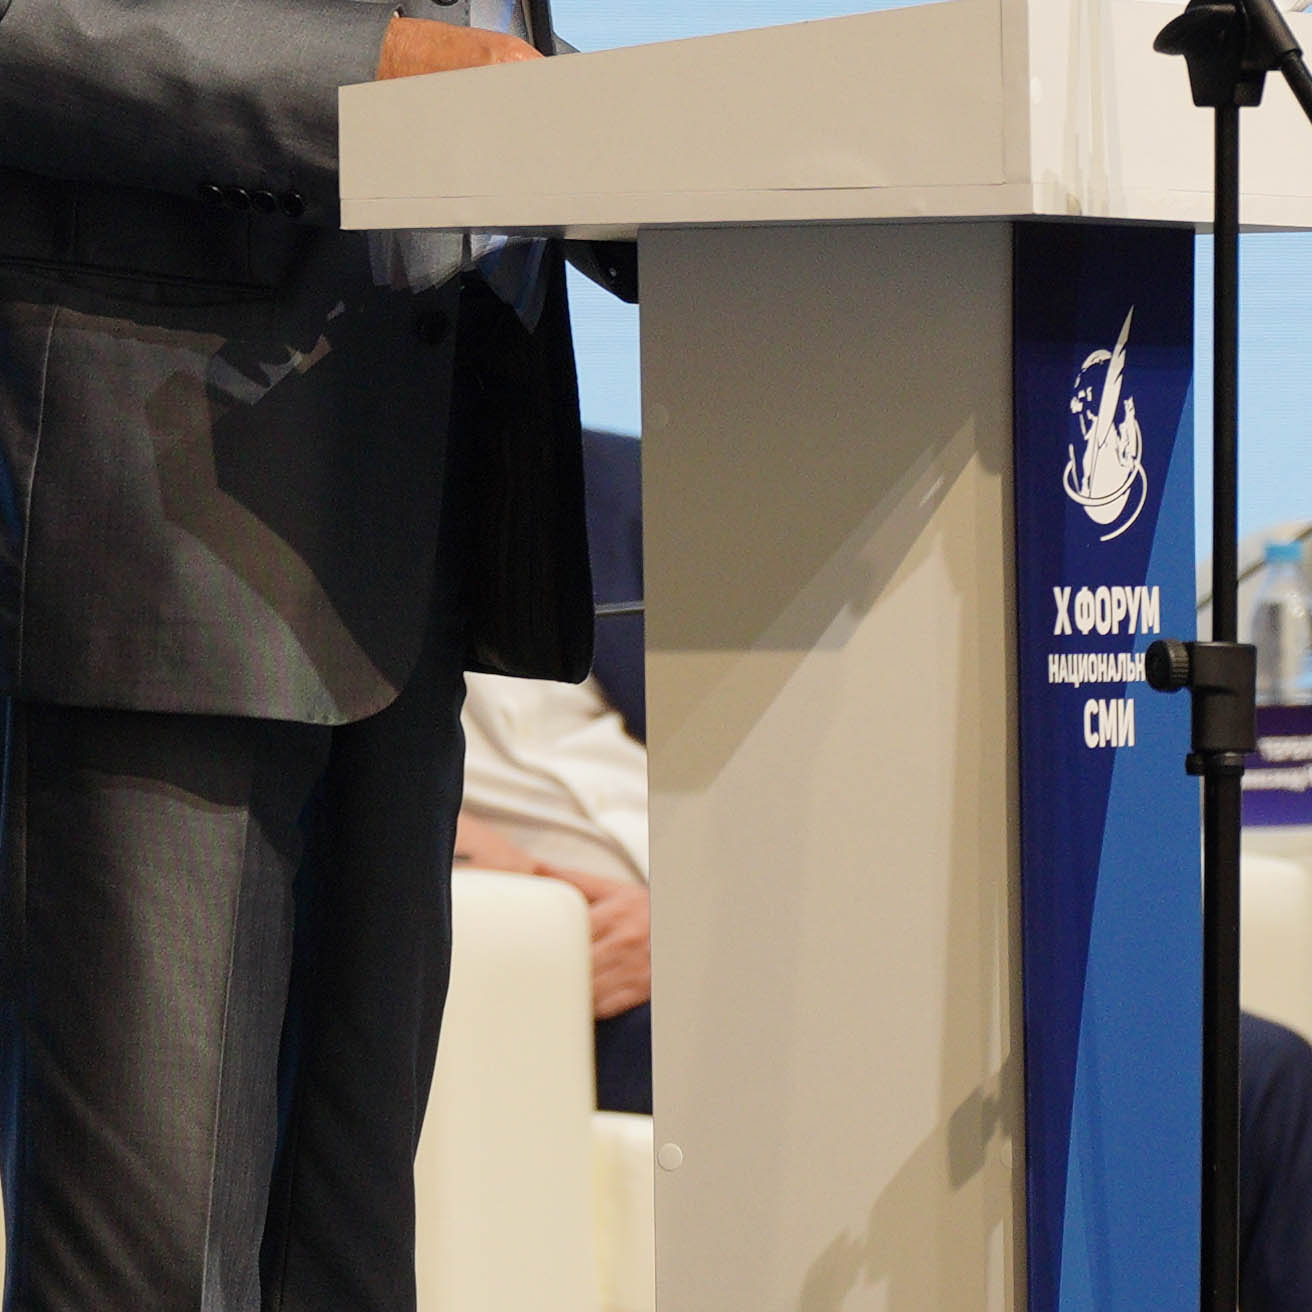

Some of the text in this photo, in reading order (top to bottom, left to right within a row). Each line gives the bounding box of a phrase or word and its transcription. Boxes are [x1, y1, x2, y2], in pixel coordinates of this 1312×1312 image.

[1074, 585, 1161, 635] ФОРУМ
[1048, 652, 1146, 688] НАЦИОНАЛЬН
[1083, 698, 1136, 749] СМИ
